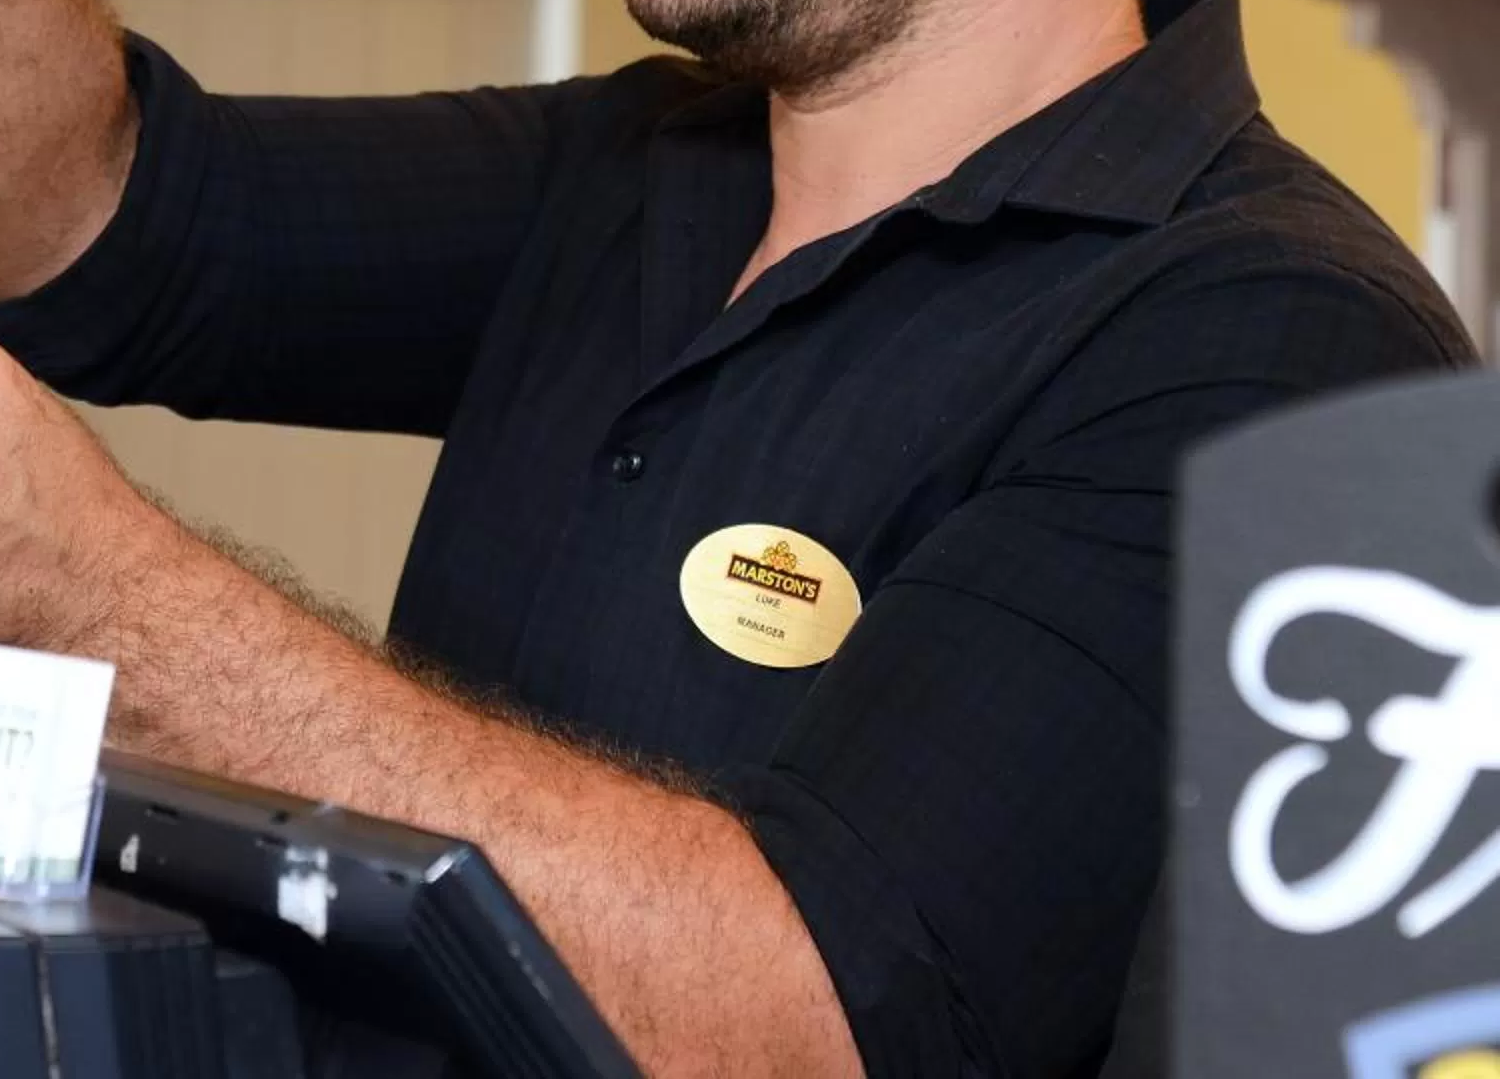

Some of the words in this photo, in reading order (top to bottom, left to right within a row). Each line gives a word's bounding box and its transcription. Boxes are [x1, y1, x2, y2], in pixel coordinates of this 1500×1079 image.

[730, 559, 818, 599] MARSTON'S
[755, 593, 782, 610] LUKE
[737, 616, 786, 639] MANAGER
